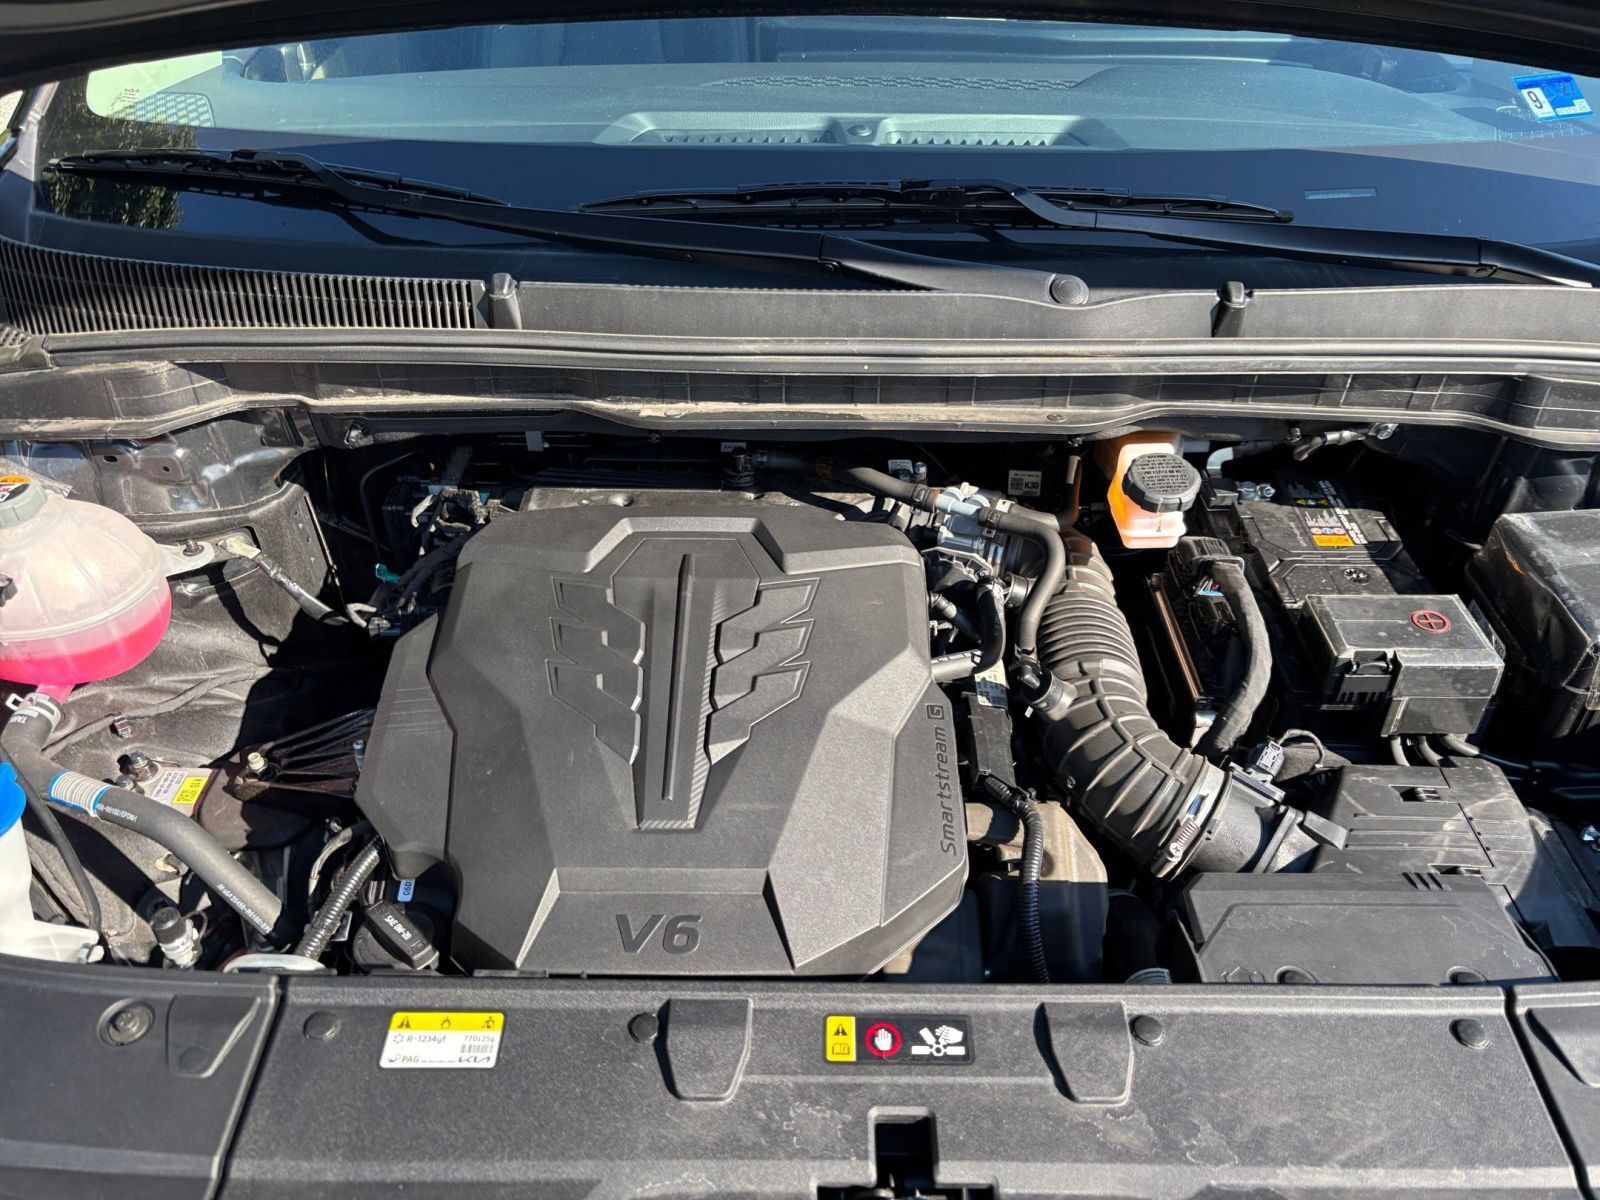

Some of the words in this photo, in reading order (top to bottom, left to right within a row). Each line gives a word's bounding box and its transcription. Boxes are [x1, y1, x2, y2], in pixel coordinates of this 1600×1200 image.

[1526, 90, 1544, 109] 9
[934, 726, 957, 856] Smartstream
[402, 880, 413, 896] G6D
[384, 915, 399, 927] SAE
[616, 914, 702, 954] V6
[406, 1035, 447, 1045] R-1234yf
[401, 1055, 420, 1064] PAG
[457, 1055, 491, 1064] KIA
